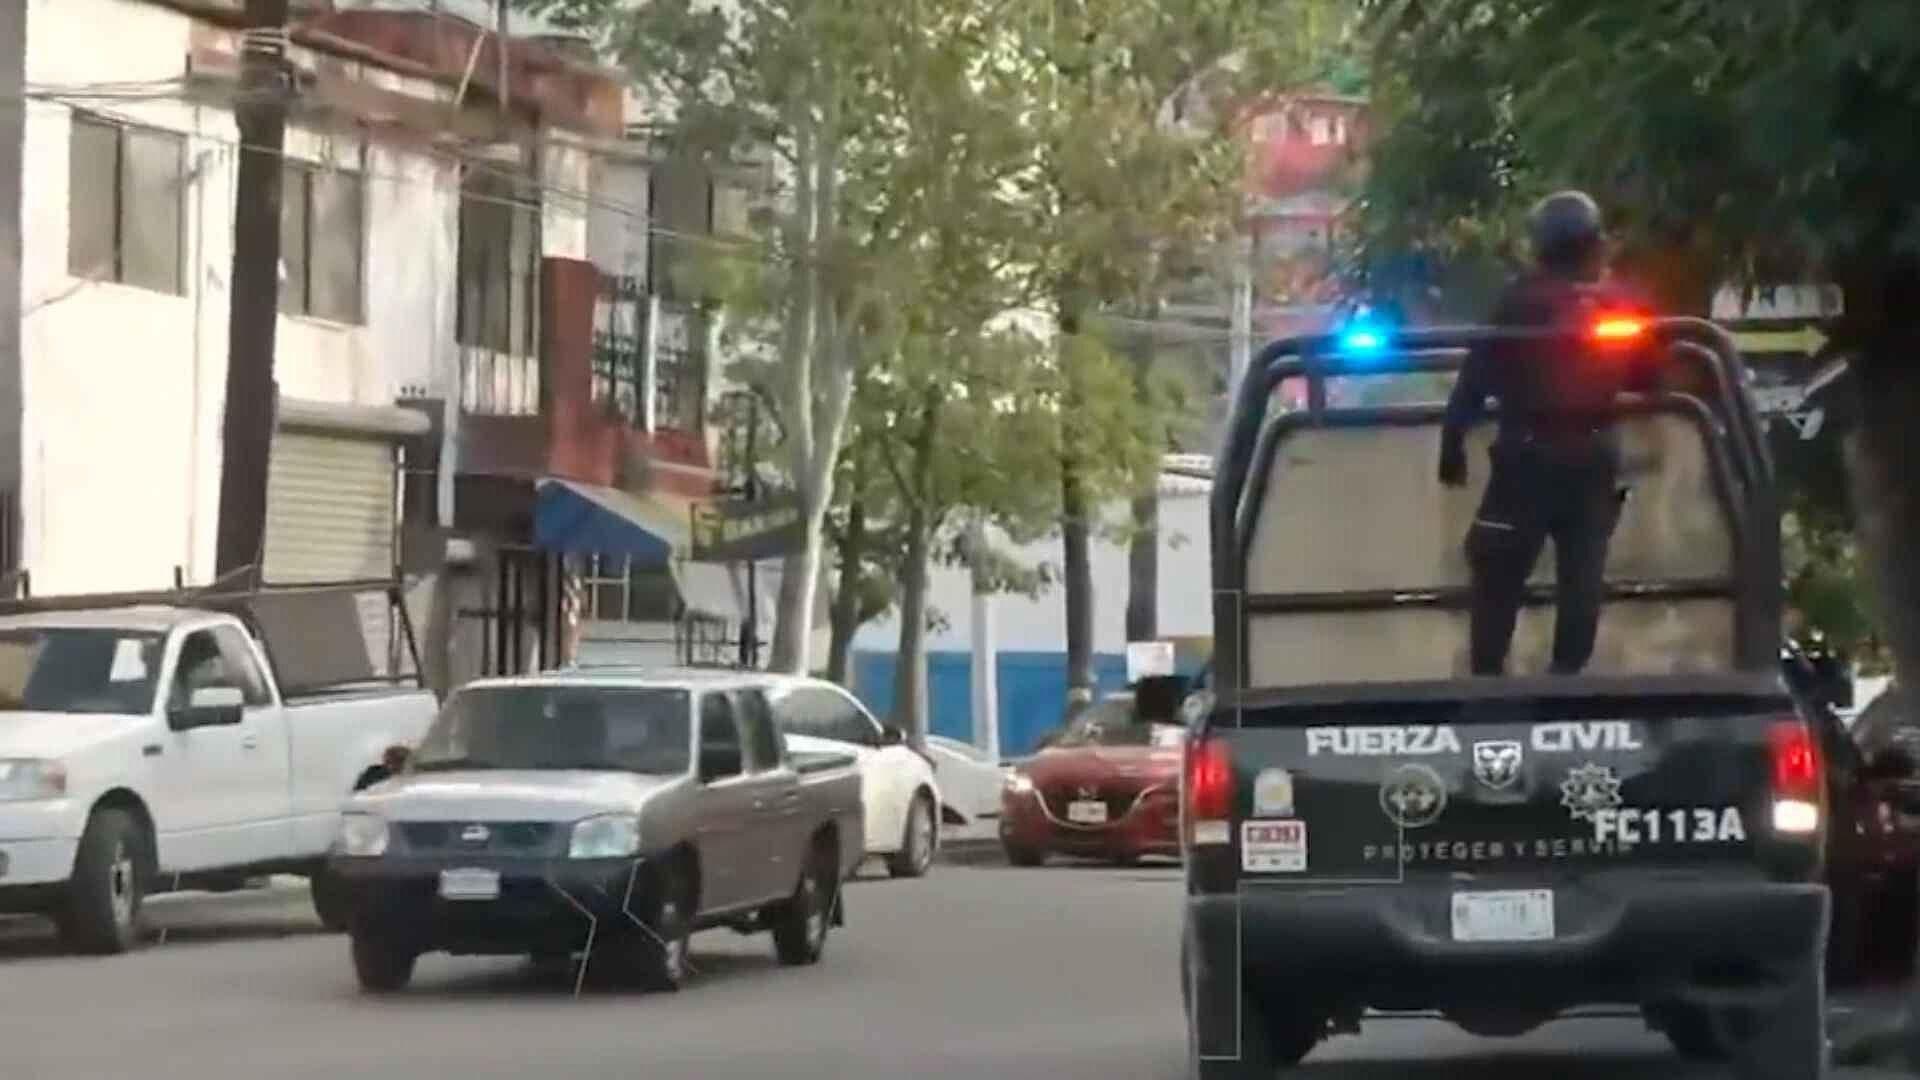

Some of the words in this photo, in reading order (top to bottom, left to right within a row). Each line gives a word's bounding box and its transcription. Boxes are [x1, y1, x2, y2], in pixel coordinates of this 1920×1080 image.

[1304, 725, 1462, 756] FUERZA
[1530, 721, 1643, 752] CIVIL
[1594, 806, 1748, 843] FC113A
[1362, 840, 1505, 861] PROTEGER
[1513, 840, 1526, 857] Y
